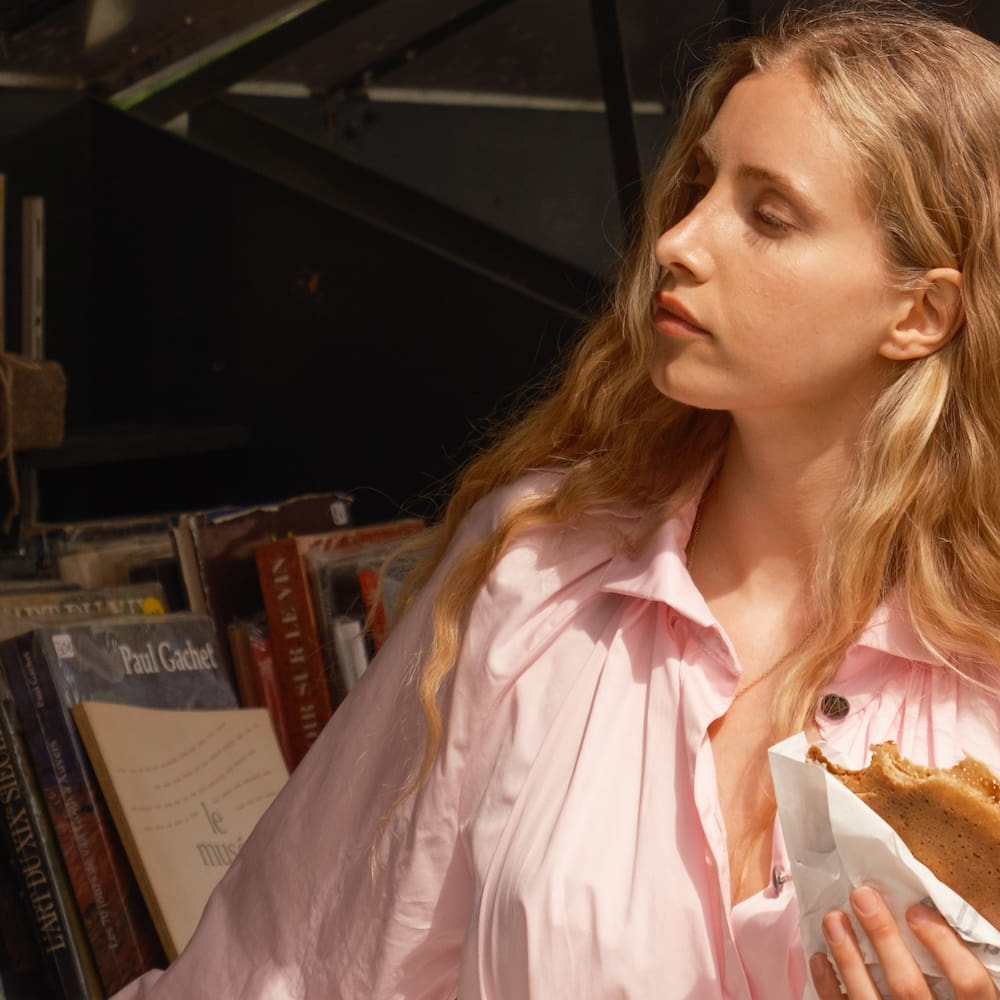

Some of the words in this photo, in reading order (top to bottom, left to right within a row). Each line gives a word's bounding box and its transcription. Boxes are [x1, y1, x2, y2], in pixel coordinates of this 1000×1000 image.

[271, 557, 292, 600] VIN
[281, 608, 299, 639] LE
[119, 643, 160, 675] Paul
[158, 639, 218, 672] Gachet
[288, 647, 310, 697] SUR
[201, 802, 227, 833] le
[196, 836, 242, 866] mus
[20, 855, 46, 888] DU
[31, 893, 65, 952] L'ART
